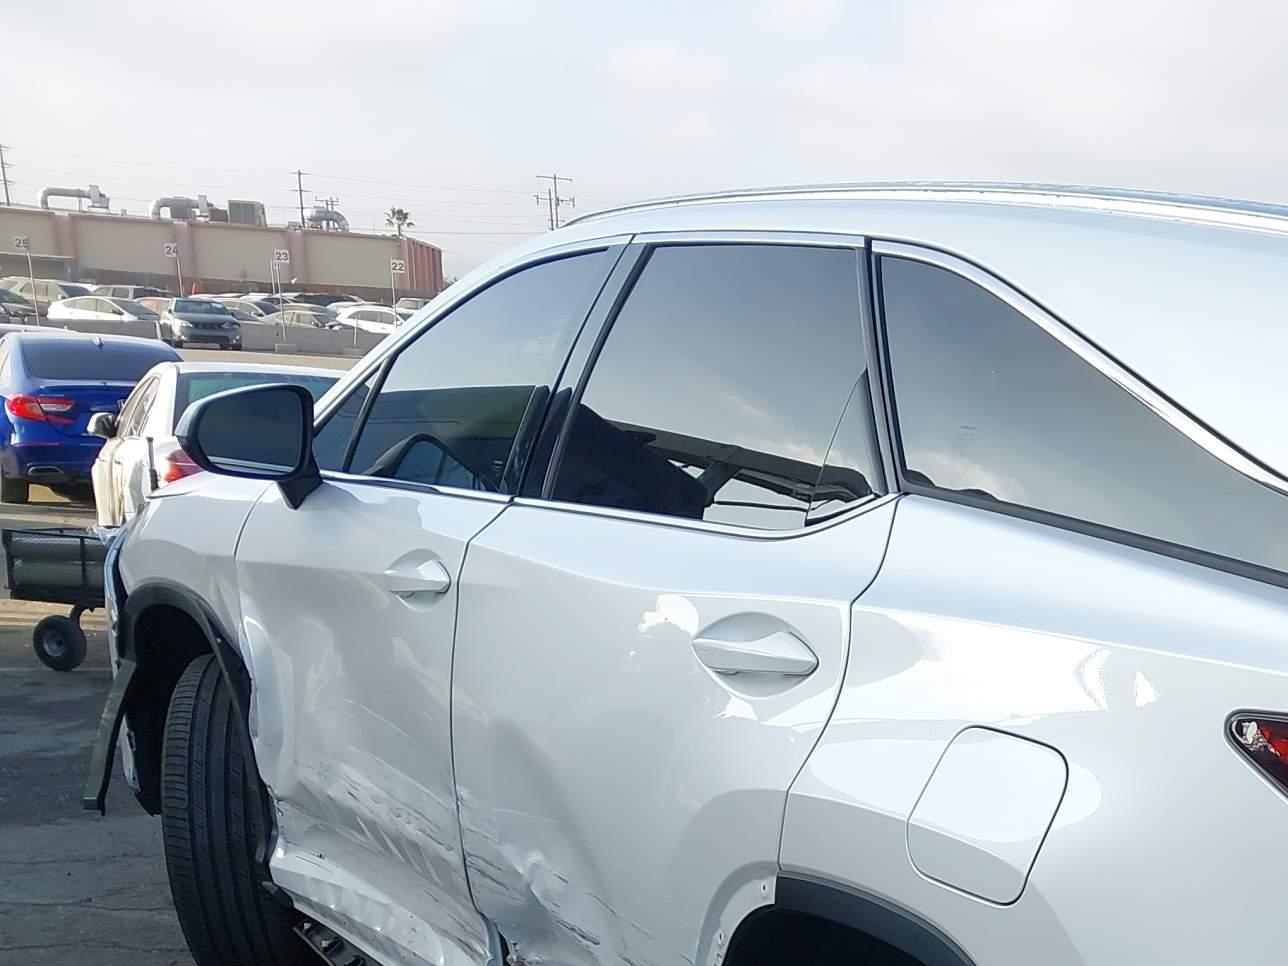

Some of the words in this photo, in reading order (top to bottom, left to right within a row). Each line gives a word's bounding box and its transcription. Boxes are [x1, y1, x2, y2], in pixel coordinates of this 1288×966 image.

[14, 238, 29, 249] 25
[165, 246, 178, 255] 24
[275, 252, 289, 262] 23
[392, 262, 404, 272] 22
